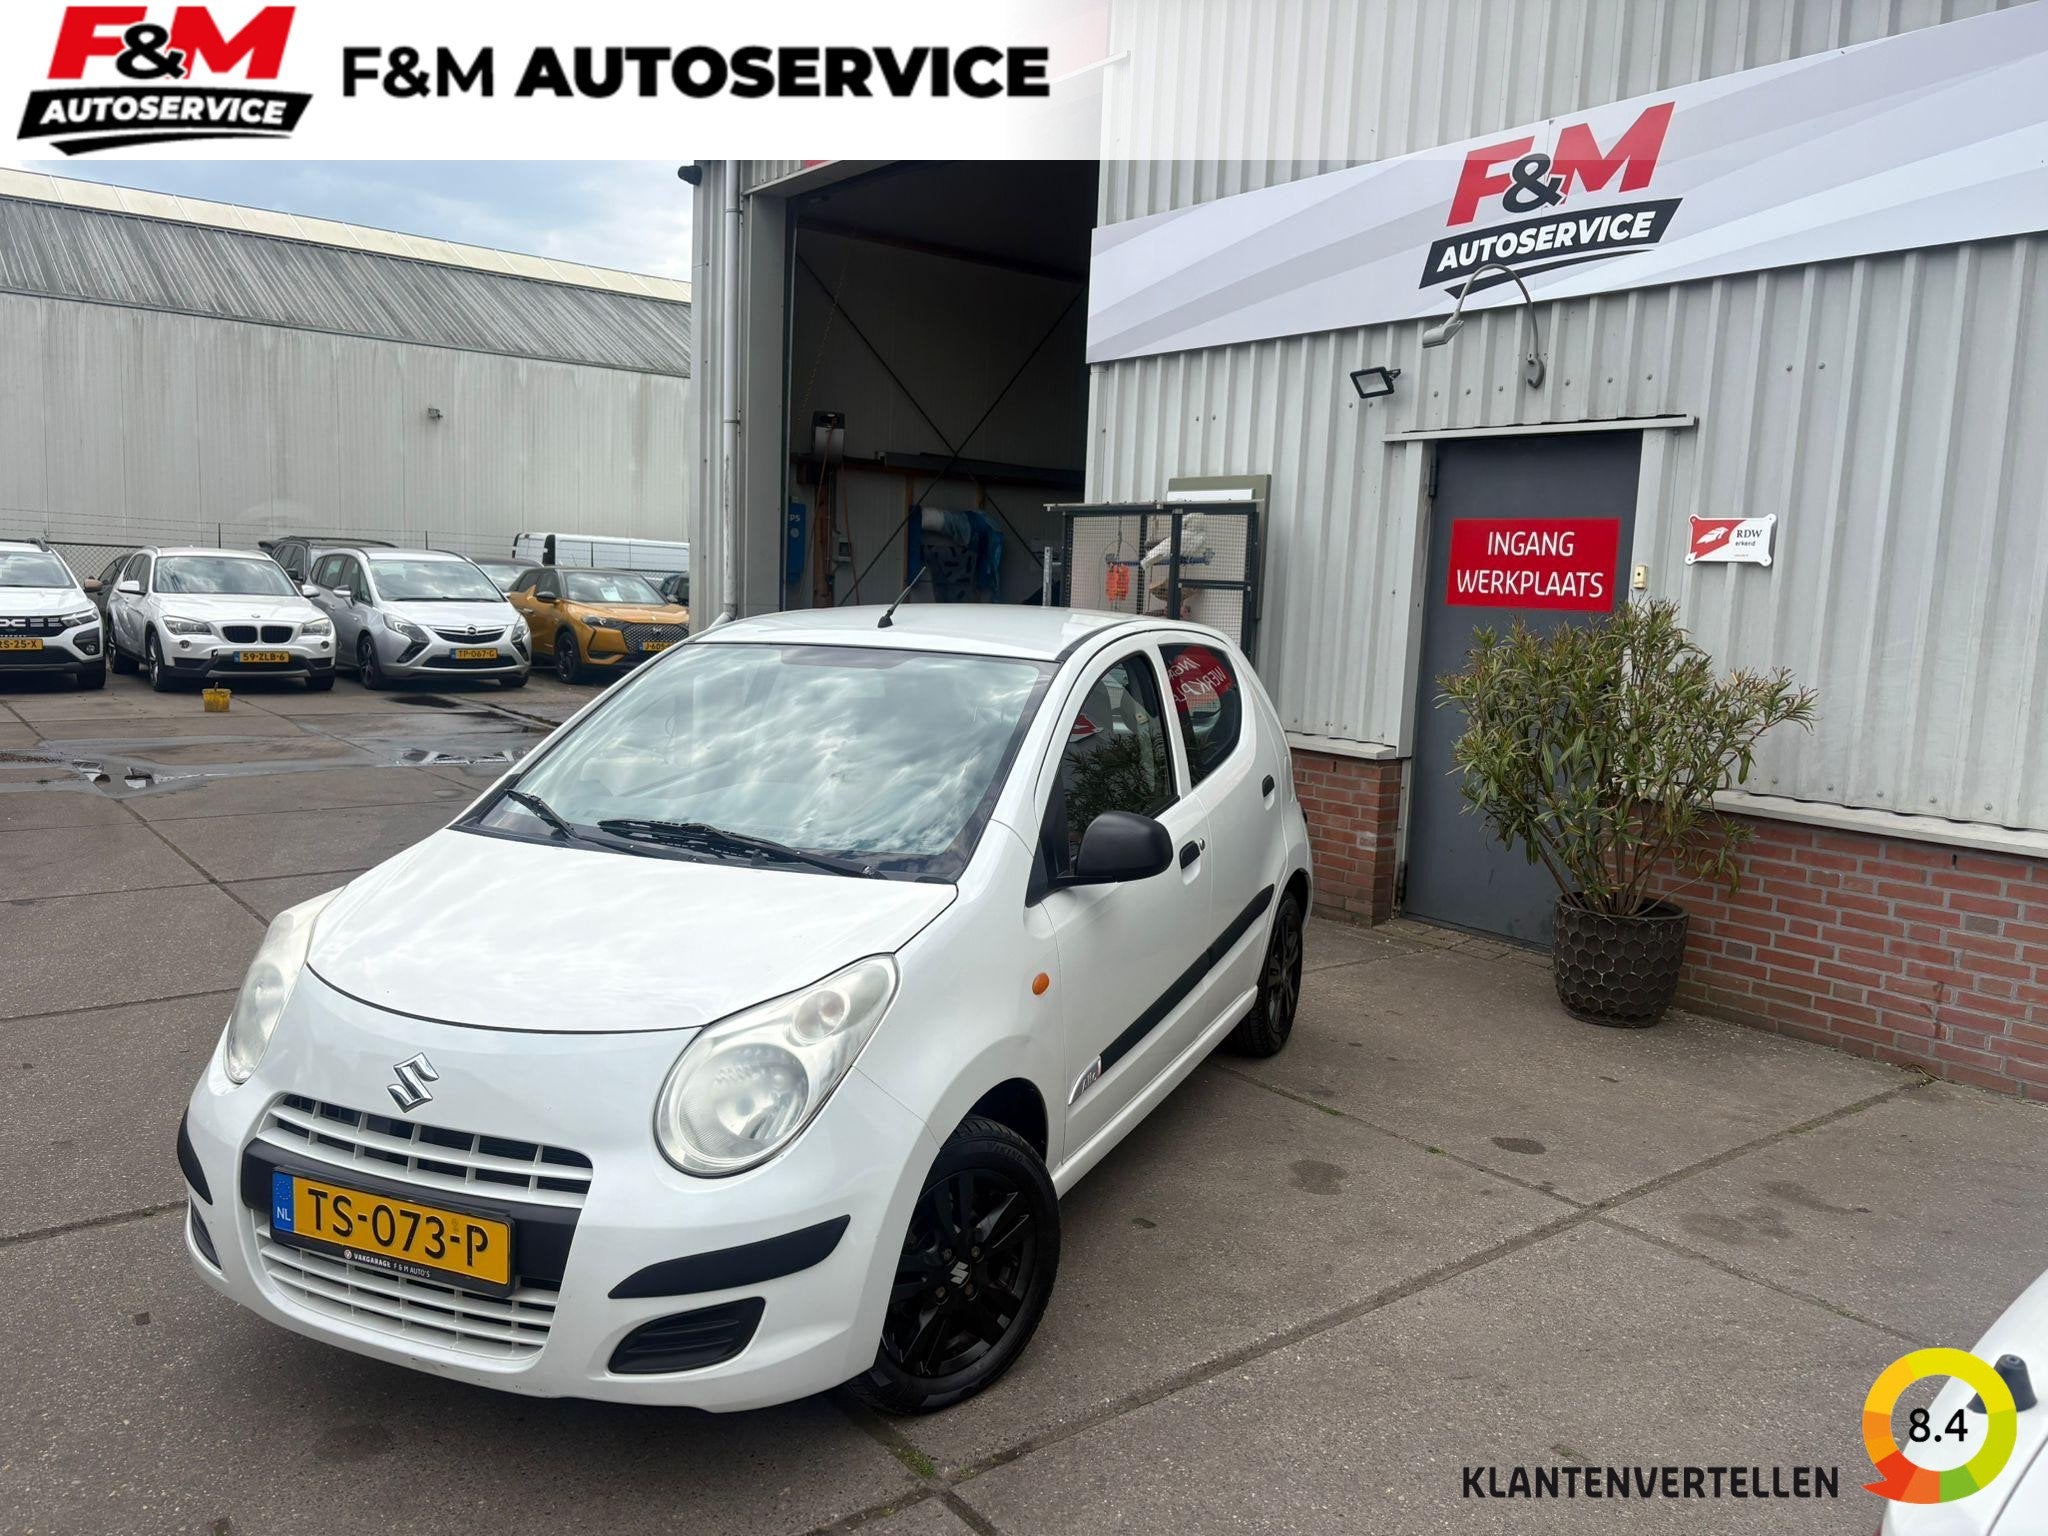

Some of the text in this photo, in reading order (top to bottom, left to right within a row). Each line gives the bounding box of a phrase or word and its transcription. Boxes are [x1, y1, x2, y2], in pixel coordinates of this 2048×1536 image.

[1447, 101, 1676, 227] F&M
[1437, 211, 1656, 272] AUTOSERVICE
[1487, 531, 1575, 557] INGANG
[1736, 529, 1762, 538] RDW
[1456, 570, 1604, 598] WERKPLAATS
[0, 639, 37, 649] S-25-X
[276, 1206, 292, 1222] NL
[307, 1187, 489, 1267] TS-073-P
[353, 1252, 391, 1268] VAKGARAGE
